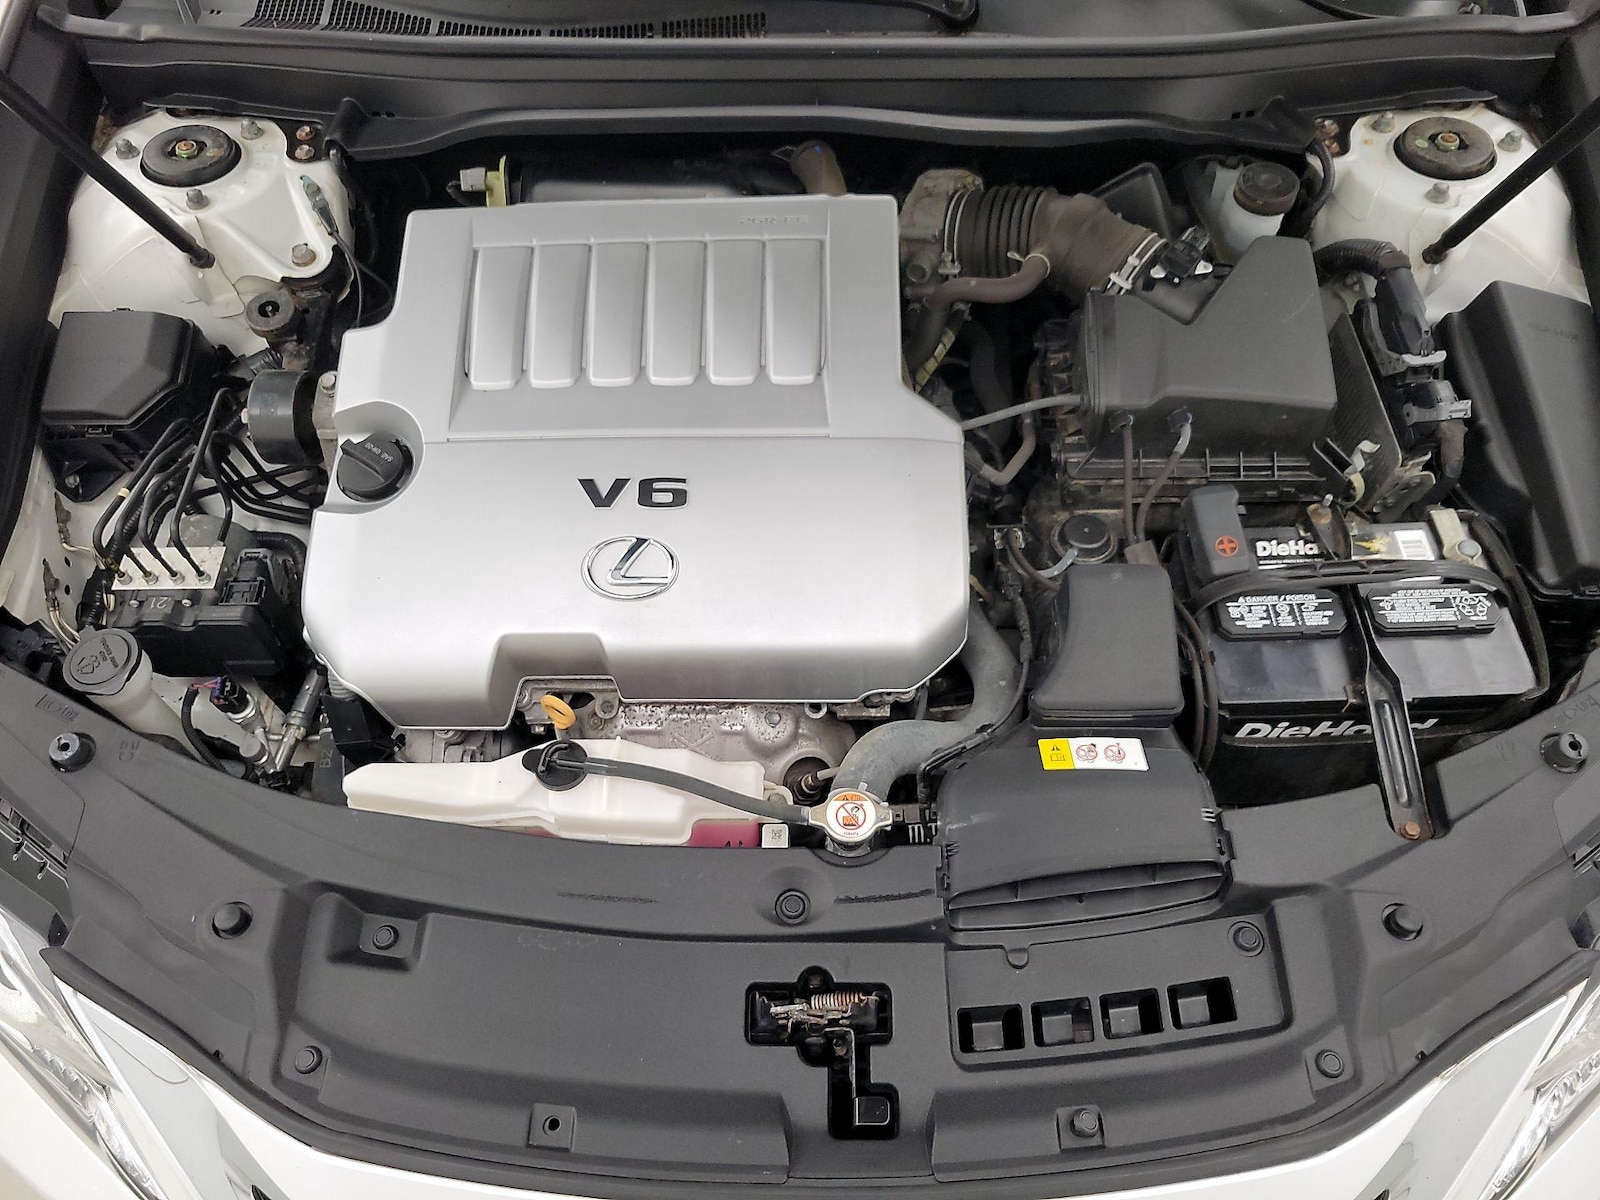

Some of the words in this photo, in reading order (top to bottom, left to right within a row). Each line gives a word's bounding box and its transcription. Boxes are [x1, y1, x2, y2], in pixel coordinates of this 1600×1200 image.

[577, 477, 687, 508] V6
[1255, 540, 1319, 557] DieHa
[1234, 718, 1439, 738] DieHa
